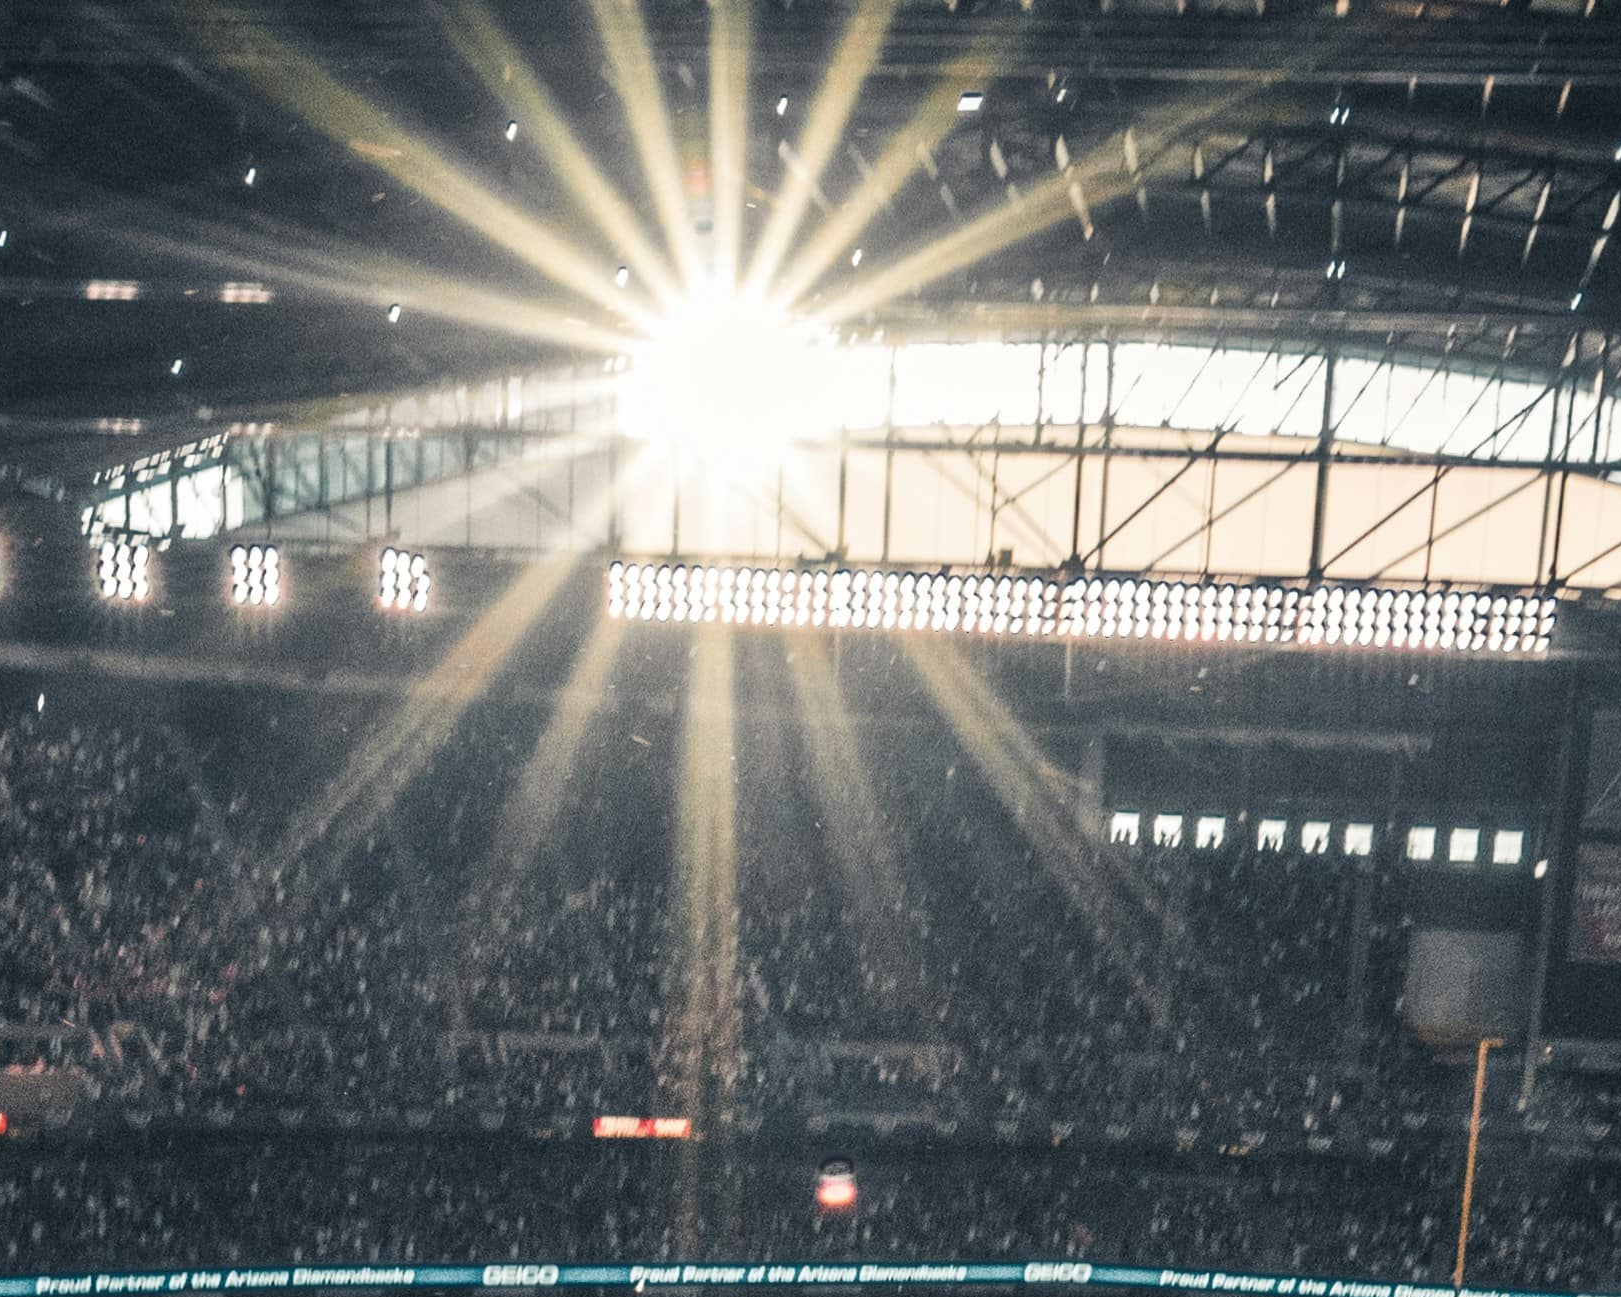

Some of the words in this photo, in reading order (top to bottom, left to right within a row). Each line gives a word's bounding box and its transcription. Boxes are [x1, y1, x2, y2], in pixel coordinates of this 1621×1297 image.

[36, 1276, 91, 1296] Proud
[95, 1274, 165, 1293] Partner
[191, 1271, 221, 1290] the
[224, 1269, 289, 1288] Arizona
[482, 1264, 559, 1286] GEICO
[629, 1266, 679, 1284] Proud
[682, 1265, 745, 1284] Partner
[767, 1265, 795, 1283] the
[797, 1265, 857, 1283] Arizona
[1024, 1262, 1092, 1284] GEICO
[1158, 1269, 1210, 1289] Proud
[1211, 1272, 1276, 1292] Partner
[1298, 1279, 1327, 1296] the
